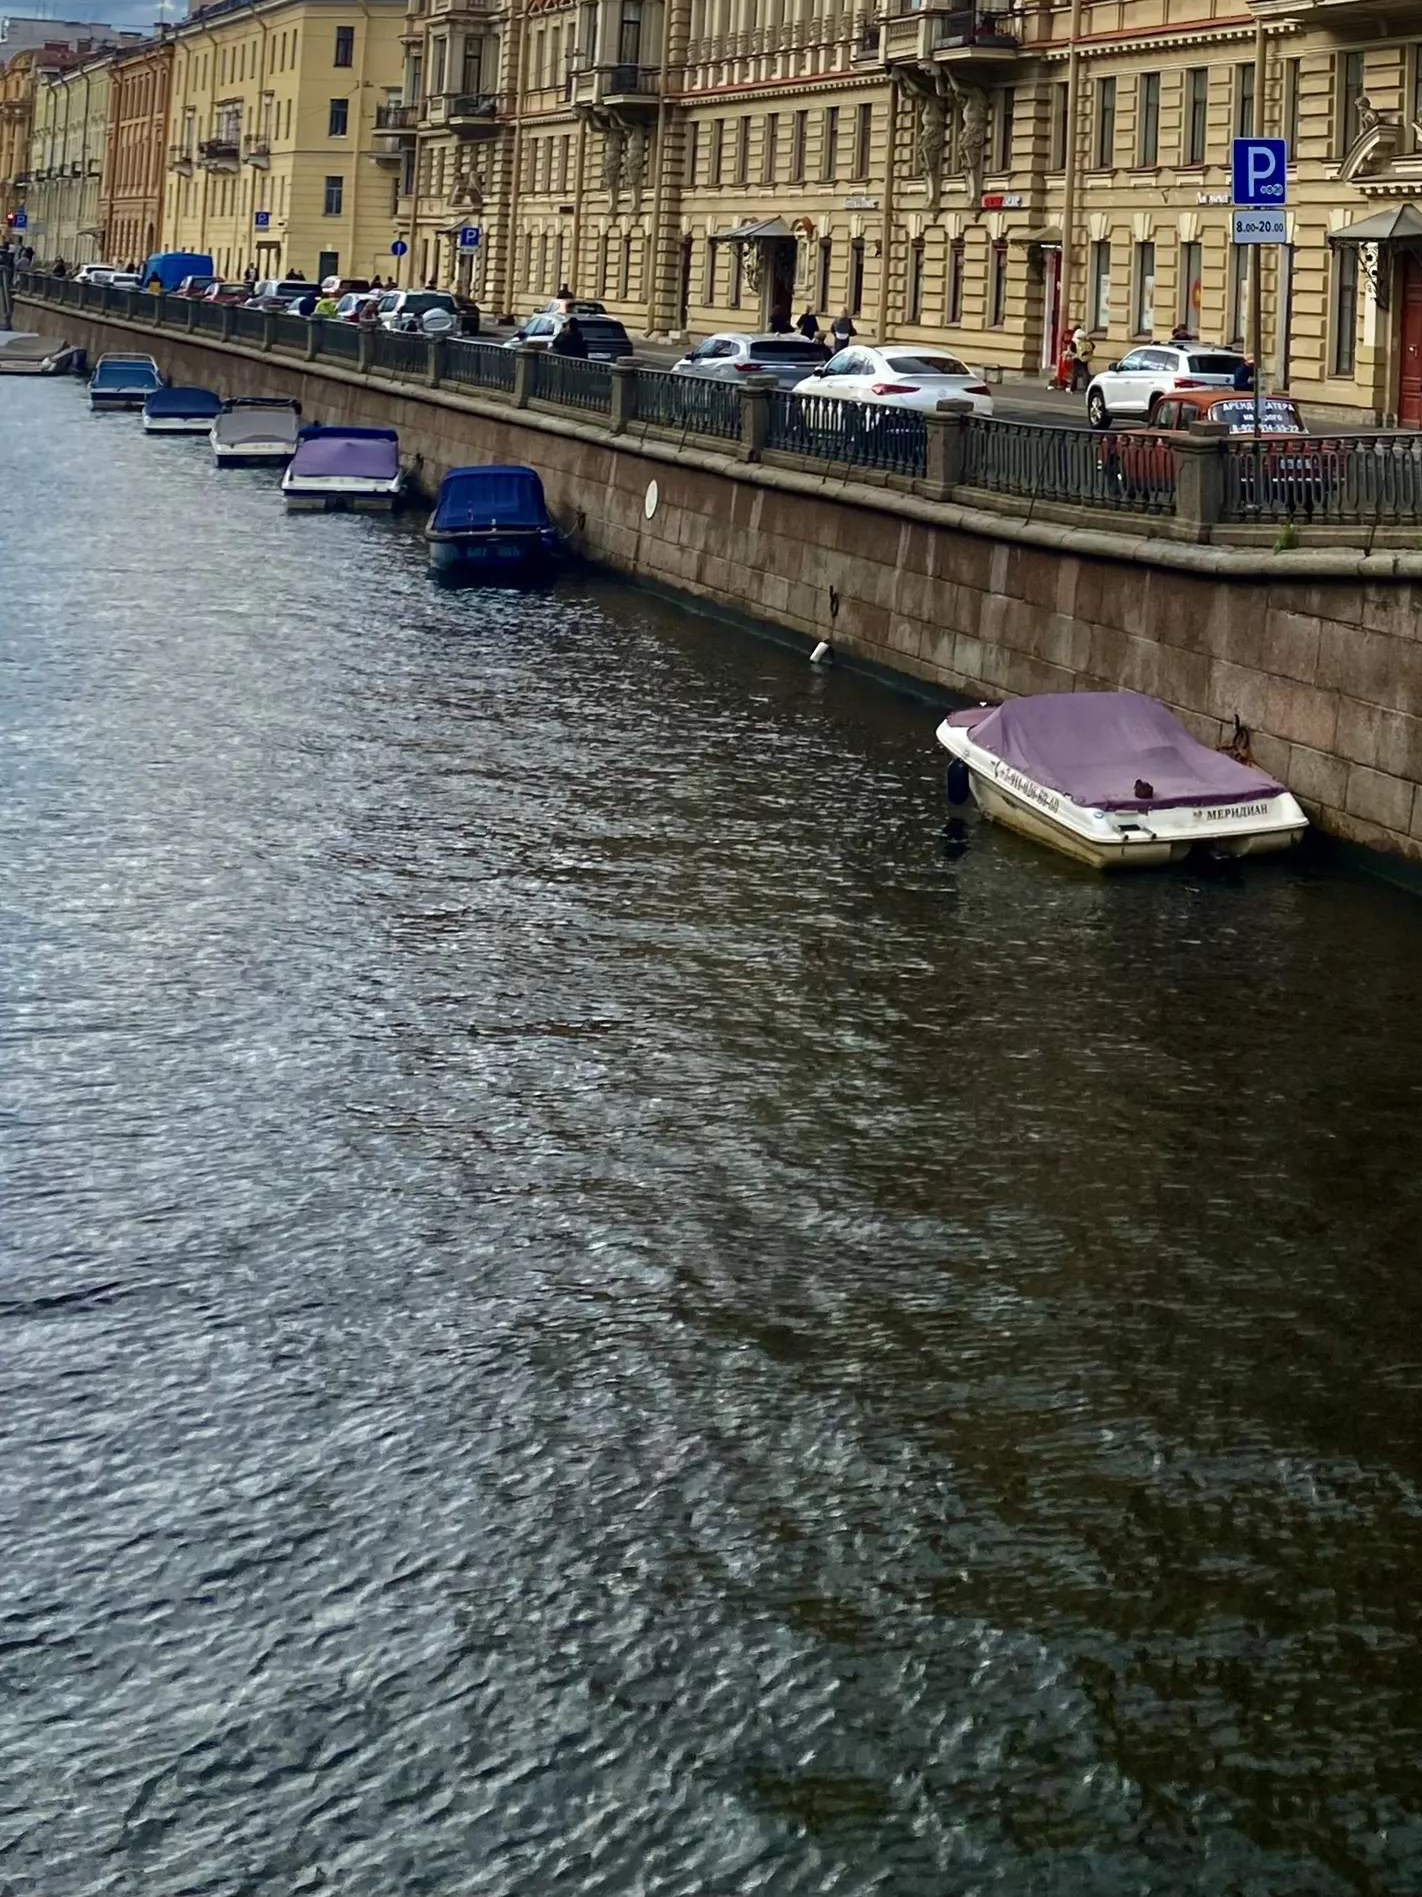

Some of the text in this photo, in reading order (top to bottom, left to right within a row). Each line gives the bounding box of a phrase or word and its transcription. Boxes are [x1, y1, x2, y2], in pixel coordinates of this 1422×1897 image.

[1248, 146, 1276, 197] P
[1236, 221, 1284, 232] 8.00-20.00
[1222, 402, 1256, 412] АРЕНД
[1206, 803, 1268, 821] МЕРИДИАН
